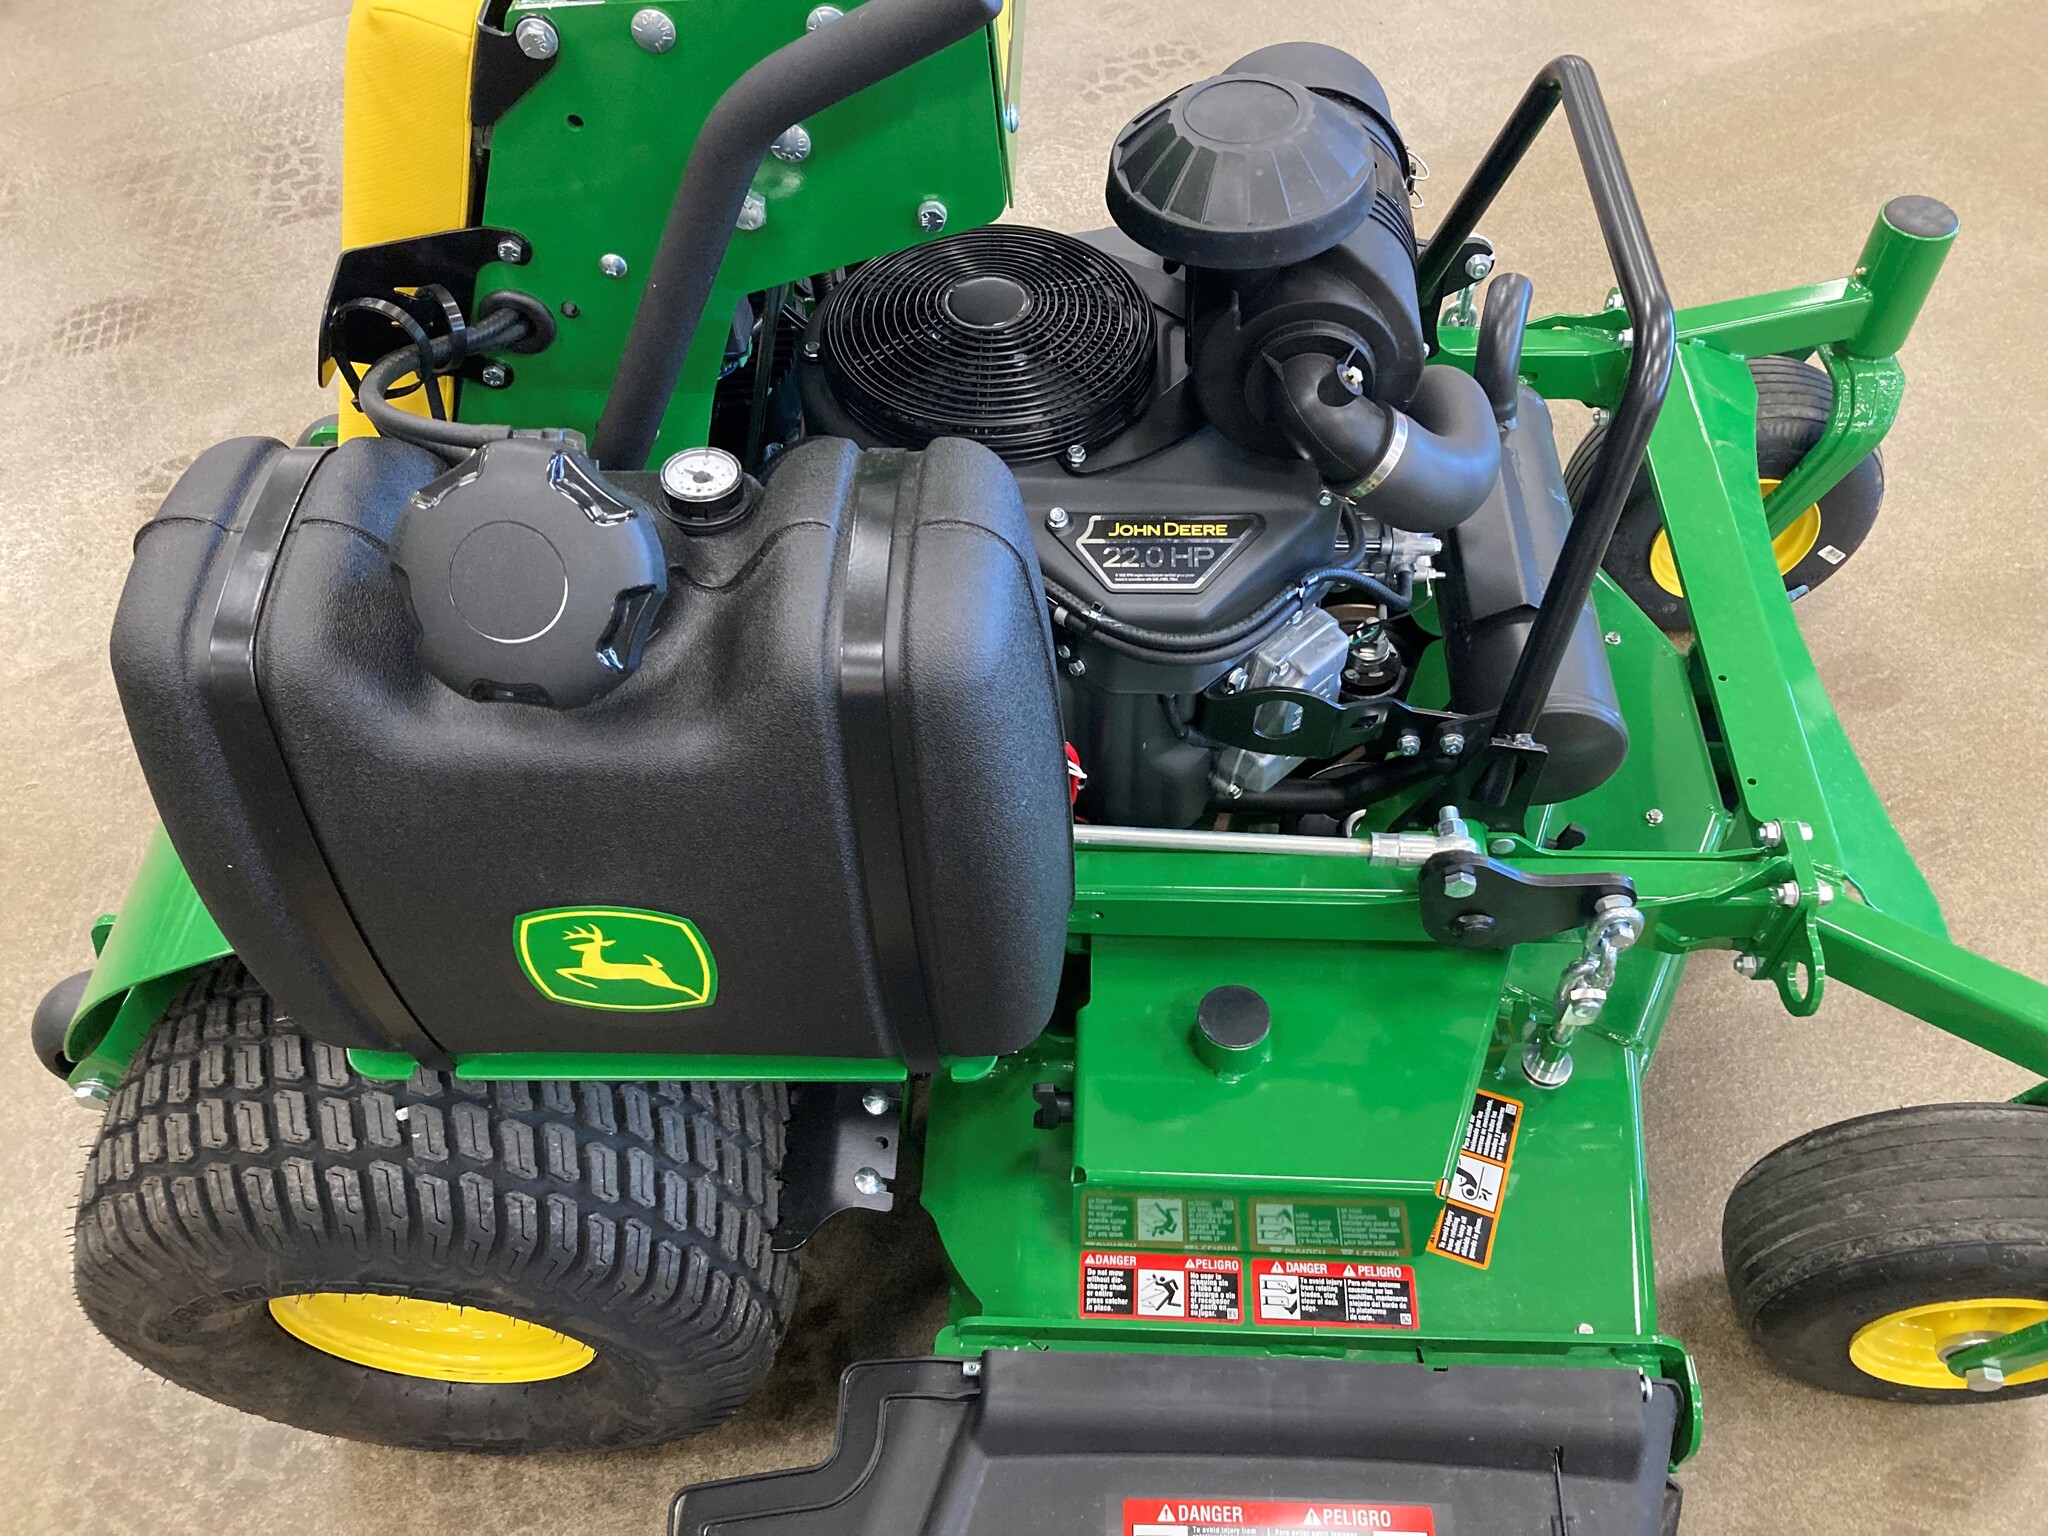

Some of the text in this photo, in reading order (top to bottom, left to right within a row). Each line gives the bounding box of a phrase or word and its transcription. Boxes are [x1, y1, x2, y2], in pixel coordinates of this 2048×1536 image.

[1108, 523, 1228, 536] JOHN DEERE
[1103, 547, 1214, 568] 22.0 HP
[1096, 1255, 1136, 1266] DANGER
[1196, 1259, 1238, 1270] PELIGRO
[1286, 1262, 1327, 1274] DANGER
[1358, 1266, 1401, 1278] PELIGRO
[1326, 1278, 1342, 1286] injury
[1178, 1505, 1243, 1522] DANGER
[1324, 1510, 1391, 1527] PELIGRO
